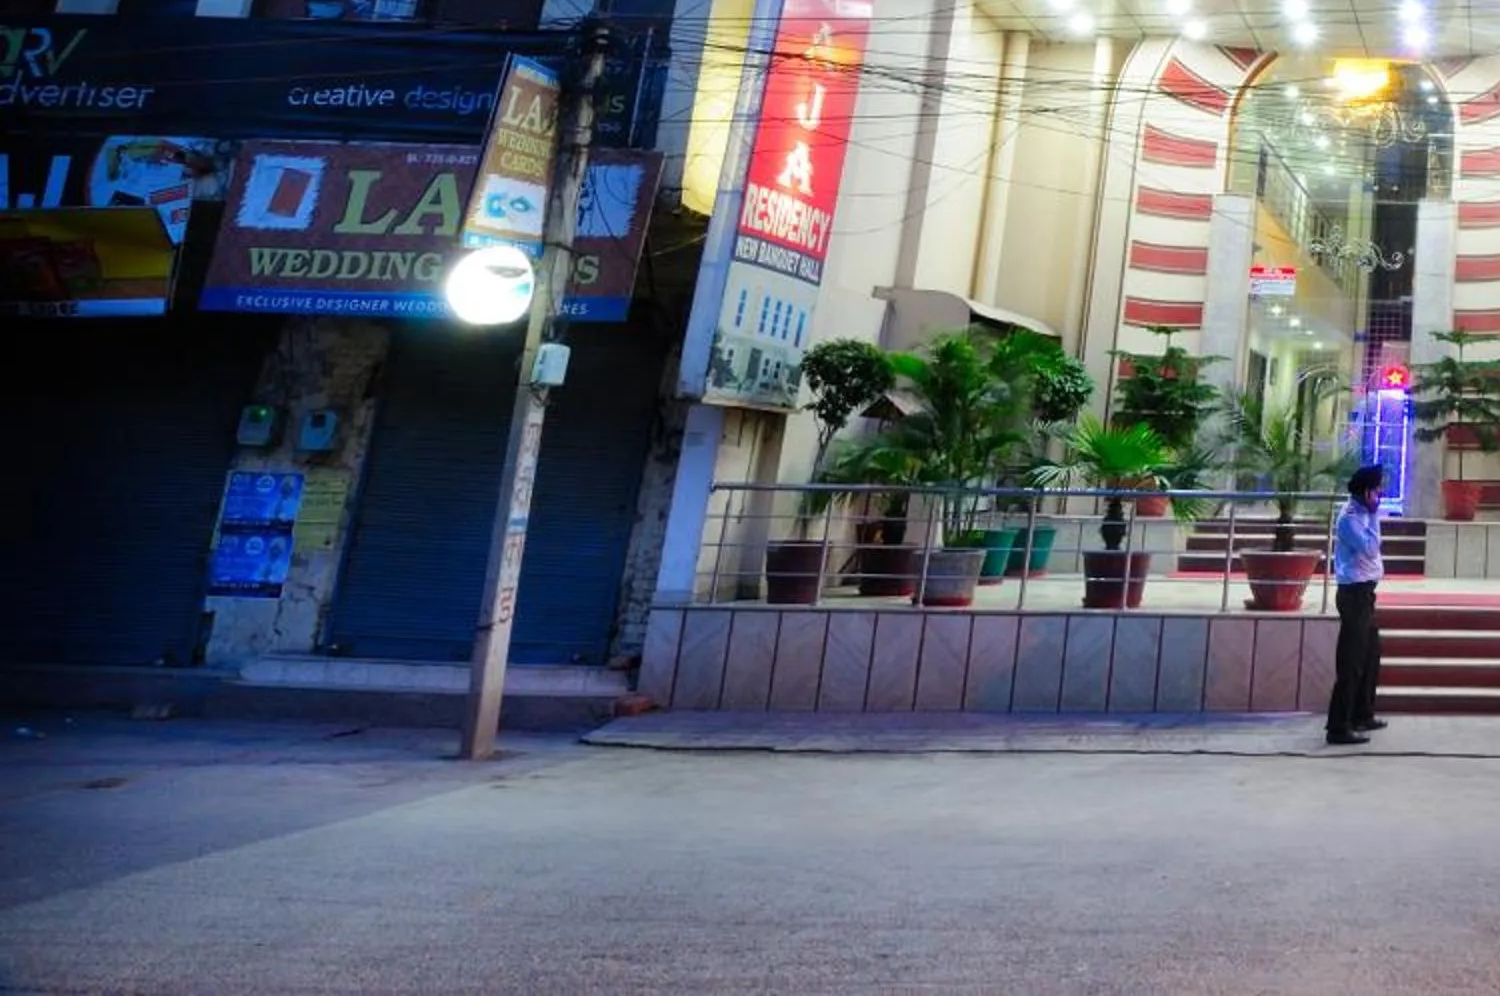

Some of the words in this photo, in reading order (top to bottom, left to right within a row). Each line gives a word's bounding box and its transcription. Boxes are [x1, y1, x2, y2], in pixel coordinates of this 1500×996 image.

[0, 69, 155, 108] dvertiser
[334, 168, 462, 237] LA
[741, 181, 831, 253] RESIDENCY
[248, 246, 444, 283] WEDDING
